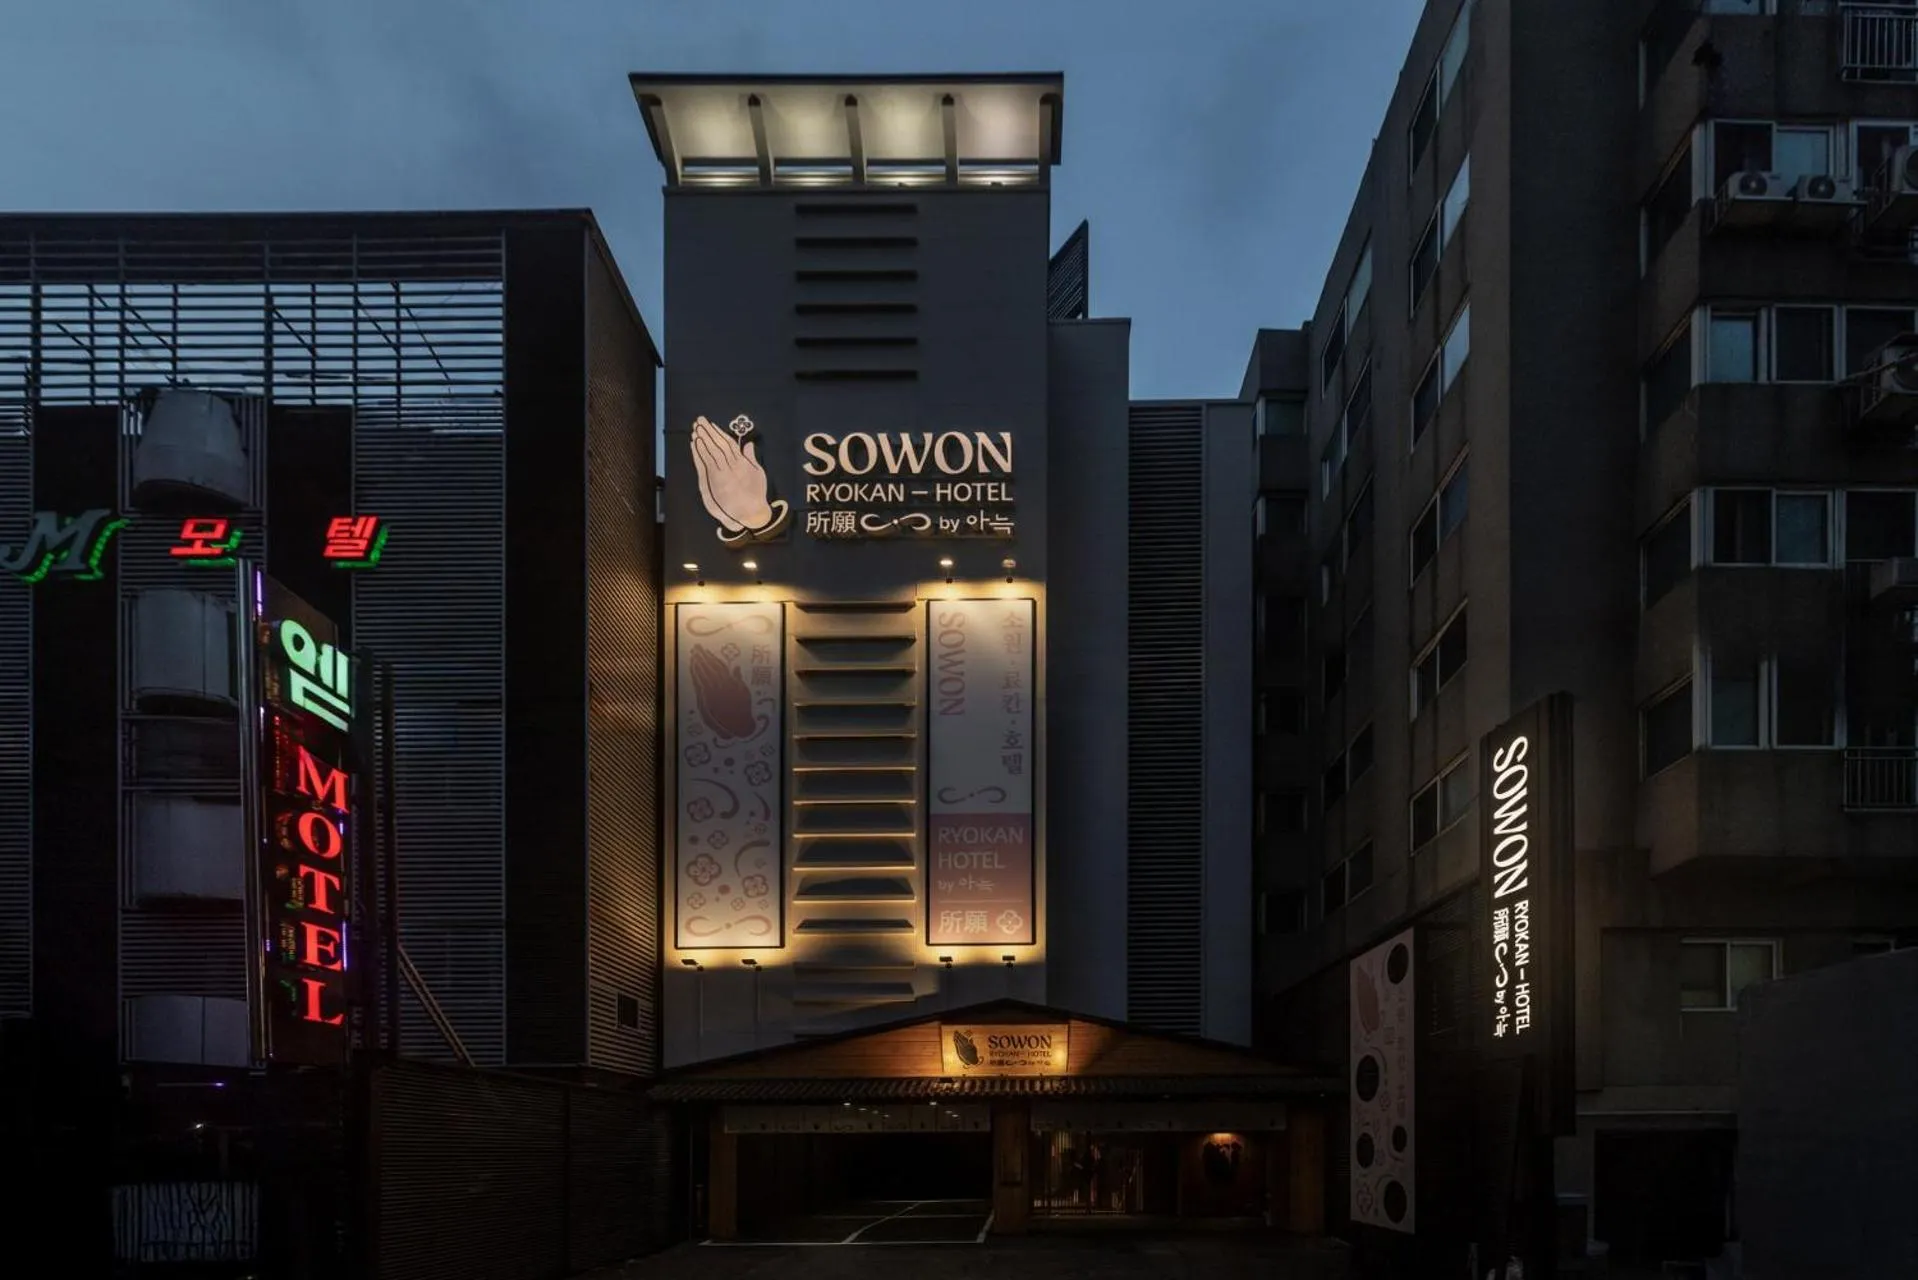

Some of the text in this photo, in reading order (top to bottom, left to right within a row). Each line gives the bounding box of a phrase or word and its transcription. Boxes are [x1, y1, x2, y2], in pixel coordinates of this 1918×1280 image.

[801, 430, 1014, 475] SOWON
[806, 483, 904, 502] RYOKAN
[936, 482, 1014, 502] HOTEL
[806, 509, 1015, 535] 所願 by 아늑
[938, 612, 966, 717] SOWON
[1493, 735, 1529, 899] SOWON
[938, 826, 1025, 845] RYOKAN
[938, 851, 1007, 869] HOTEL
[295, 743, 350, 1026] MOTEL
[938, 910, 989, 934] 所願
[1514, 899, 1530, 967] RYOKAN
[1494, 989, 1507, 1005] by
[1515, 982, 1531, 1035] HOTEL
[988, 1034, 1053, 1050] SOWON
